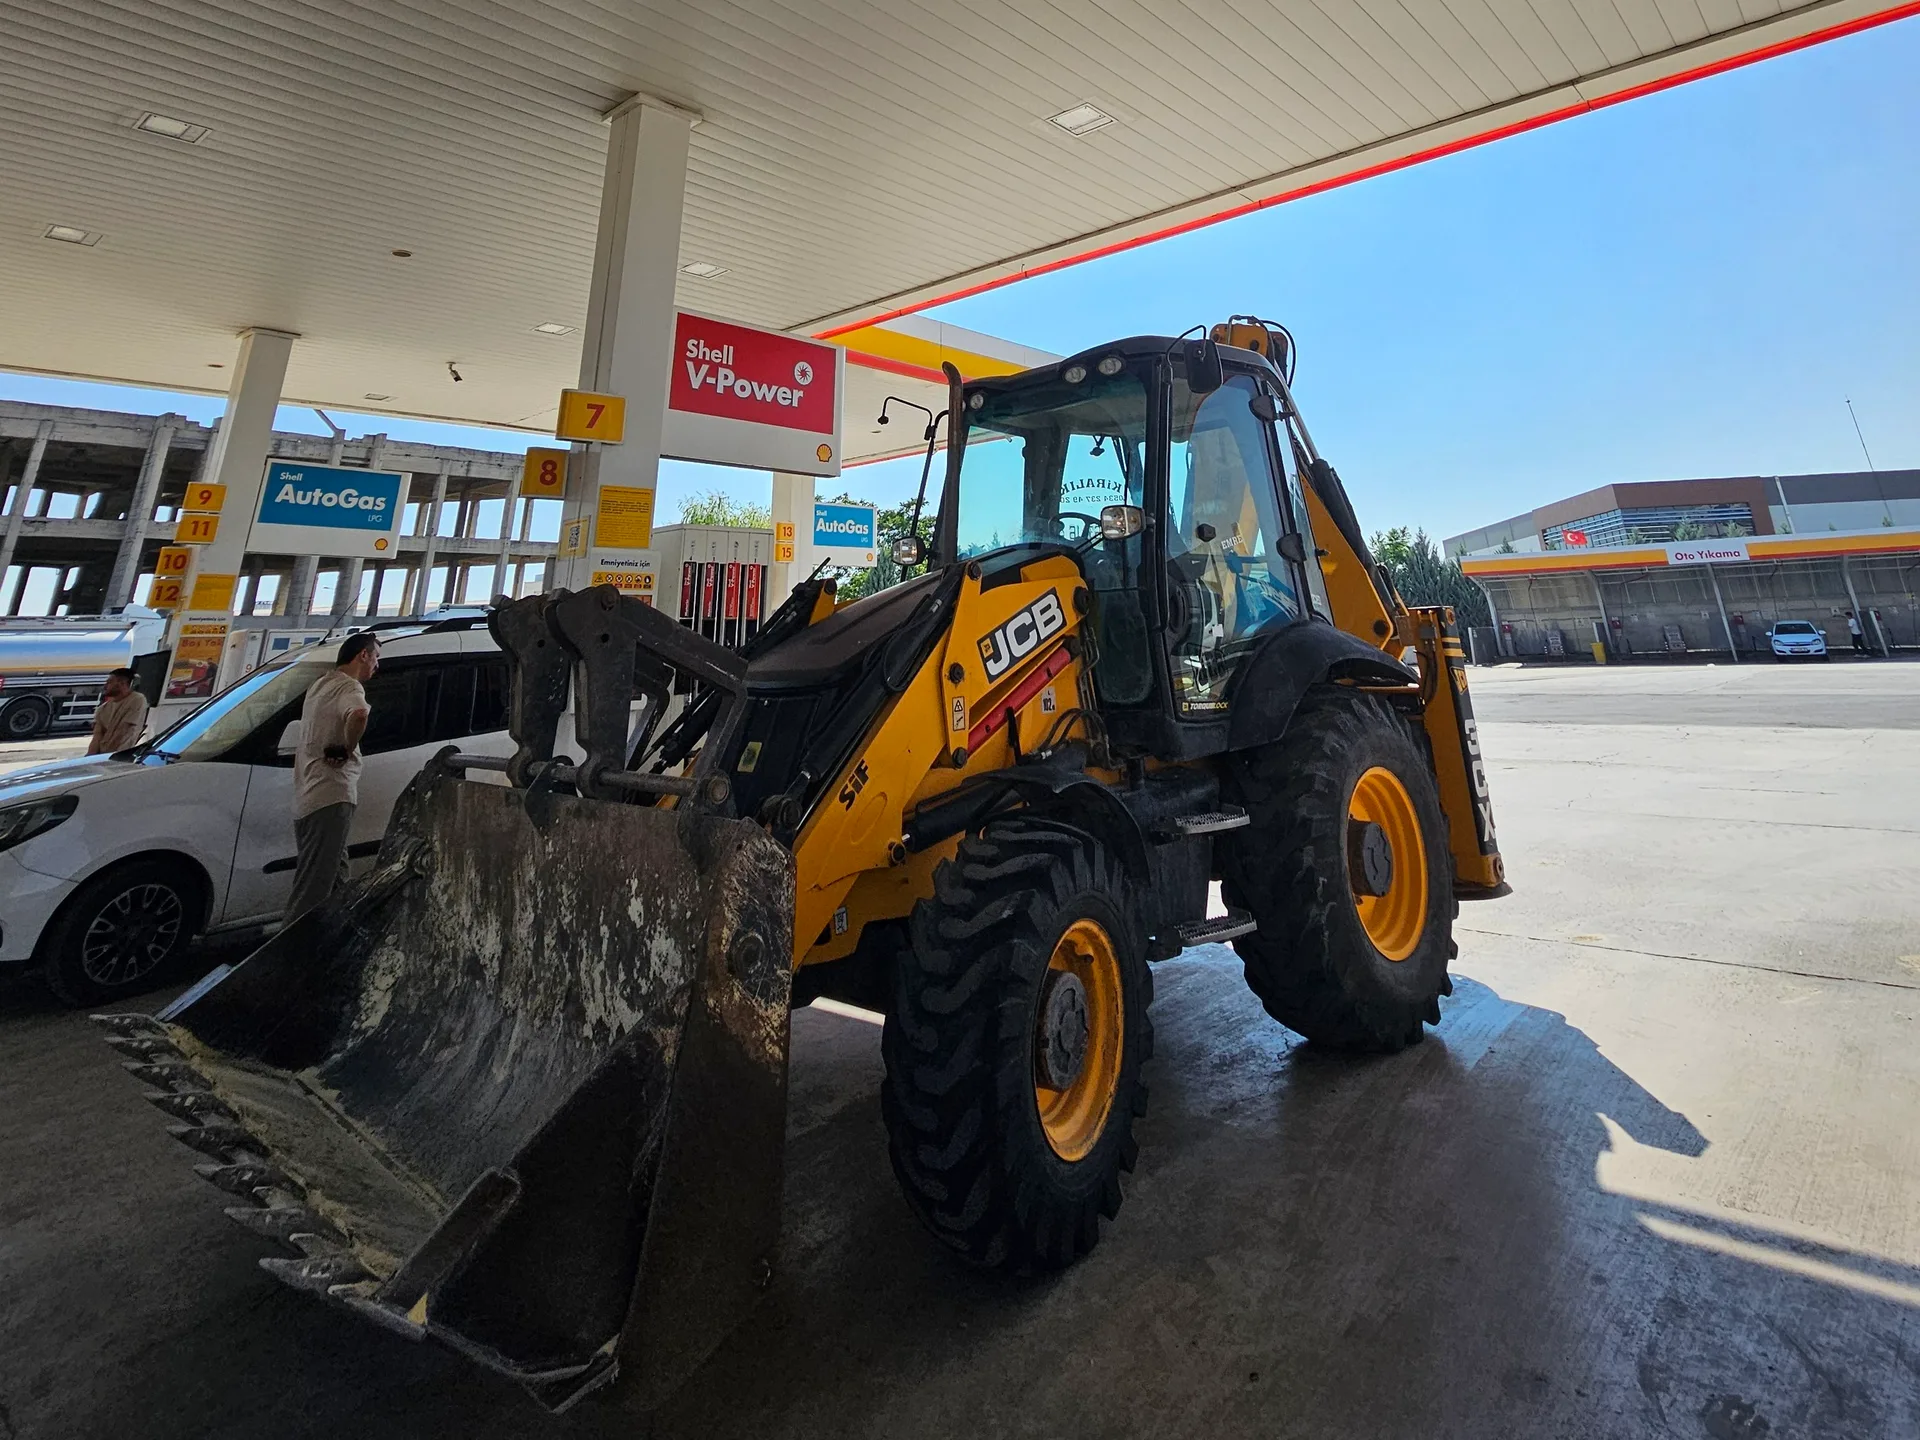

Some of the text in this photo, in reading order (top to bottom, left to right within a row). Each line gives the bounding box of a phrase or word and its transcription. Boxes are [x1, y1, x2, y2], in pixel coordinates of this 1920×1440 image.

[686, 338, 734, 366] Shell
[685, 360, 804, 408] V-Power
[585, 403, 605, 429] 7
[279, 471, 304, 482] Shell
[540, 459, 558, 486] 8
[199, 489, 212, 506] 9
[274, 483, 387, 511] AutoGas
[368, 514, 383, 523] LPG
[815, 517, 869, 535] AutoGas
[190, 520, 211, 536] 11
[782, 526, 793, 537] 13
[1220, 534, 1243, 550] EMRE
[781, 547, 792, 558] 15
[1675, 550, 1741, 561] Oto Yıkama
[163, 554, 187, 570] 10
[600, 558, 639, 568] Emniyetiniz
[155, 585, 180, 601] 12
[986, 593, 1064, 676] JCB
[1464, 718, 1497, 843] 3CX
